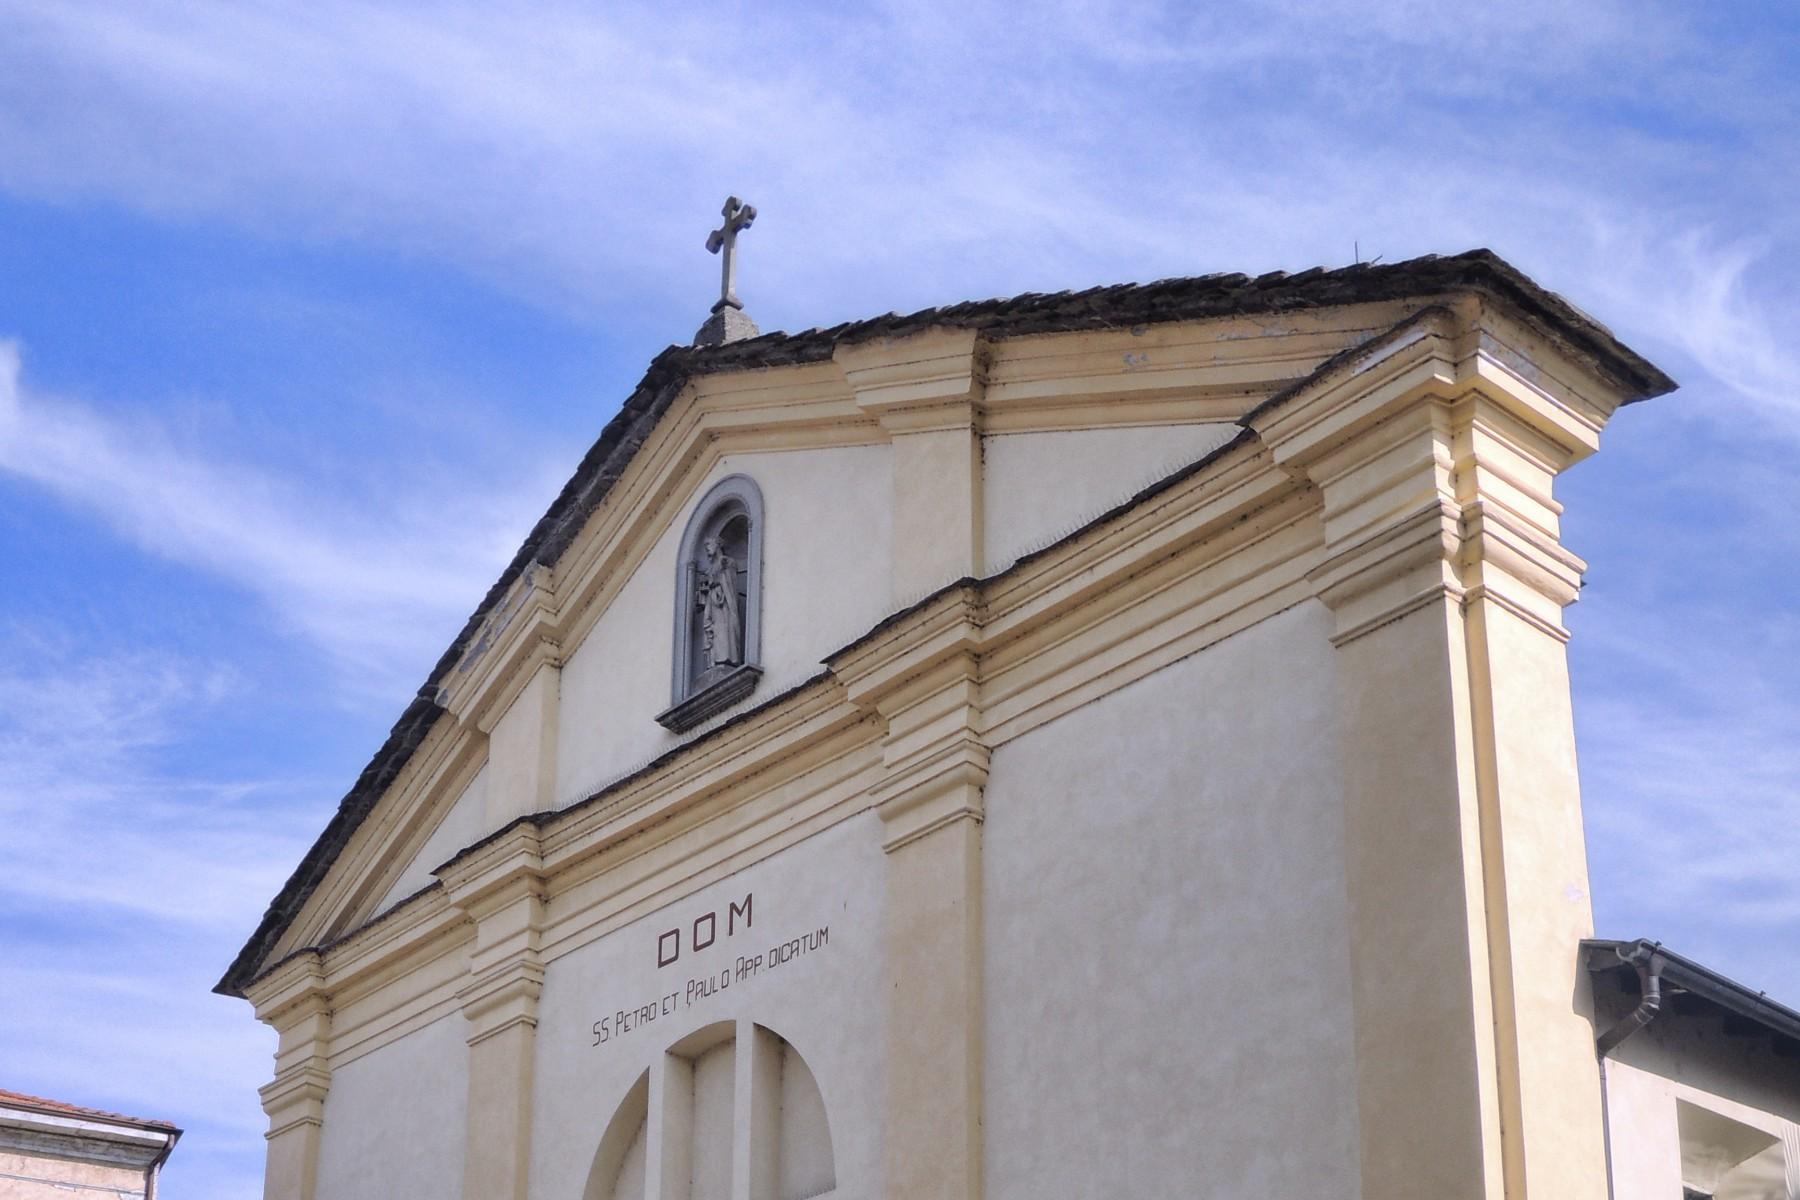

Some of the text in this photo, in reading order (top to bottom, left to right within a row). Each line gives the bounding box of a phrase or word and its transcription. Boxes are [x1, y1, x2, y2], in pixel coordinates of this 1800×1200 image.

[615, 1002, 657, 1037] PETRO
[662, 992, 680, 1016] ET
[686, 968, 730, 1005] PAULO
[768, 926, 829, 969] DICATUM
